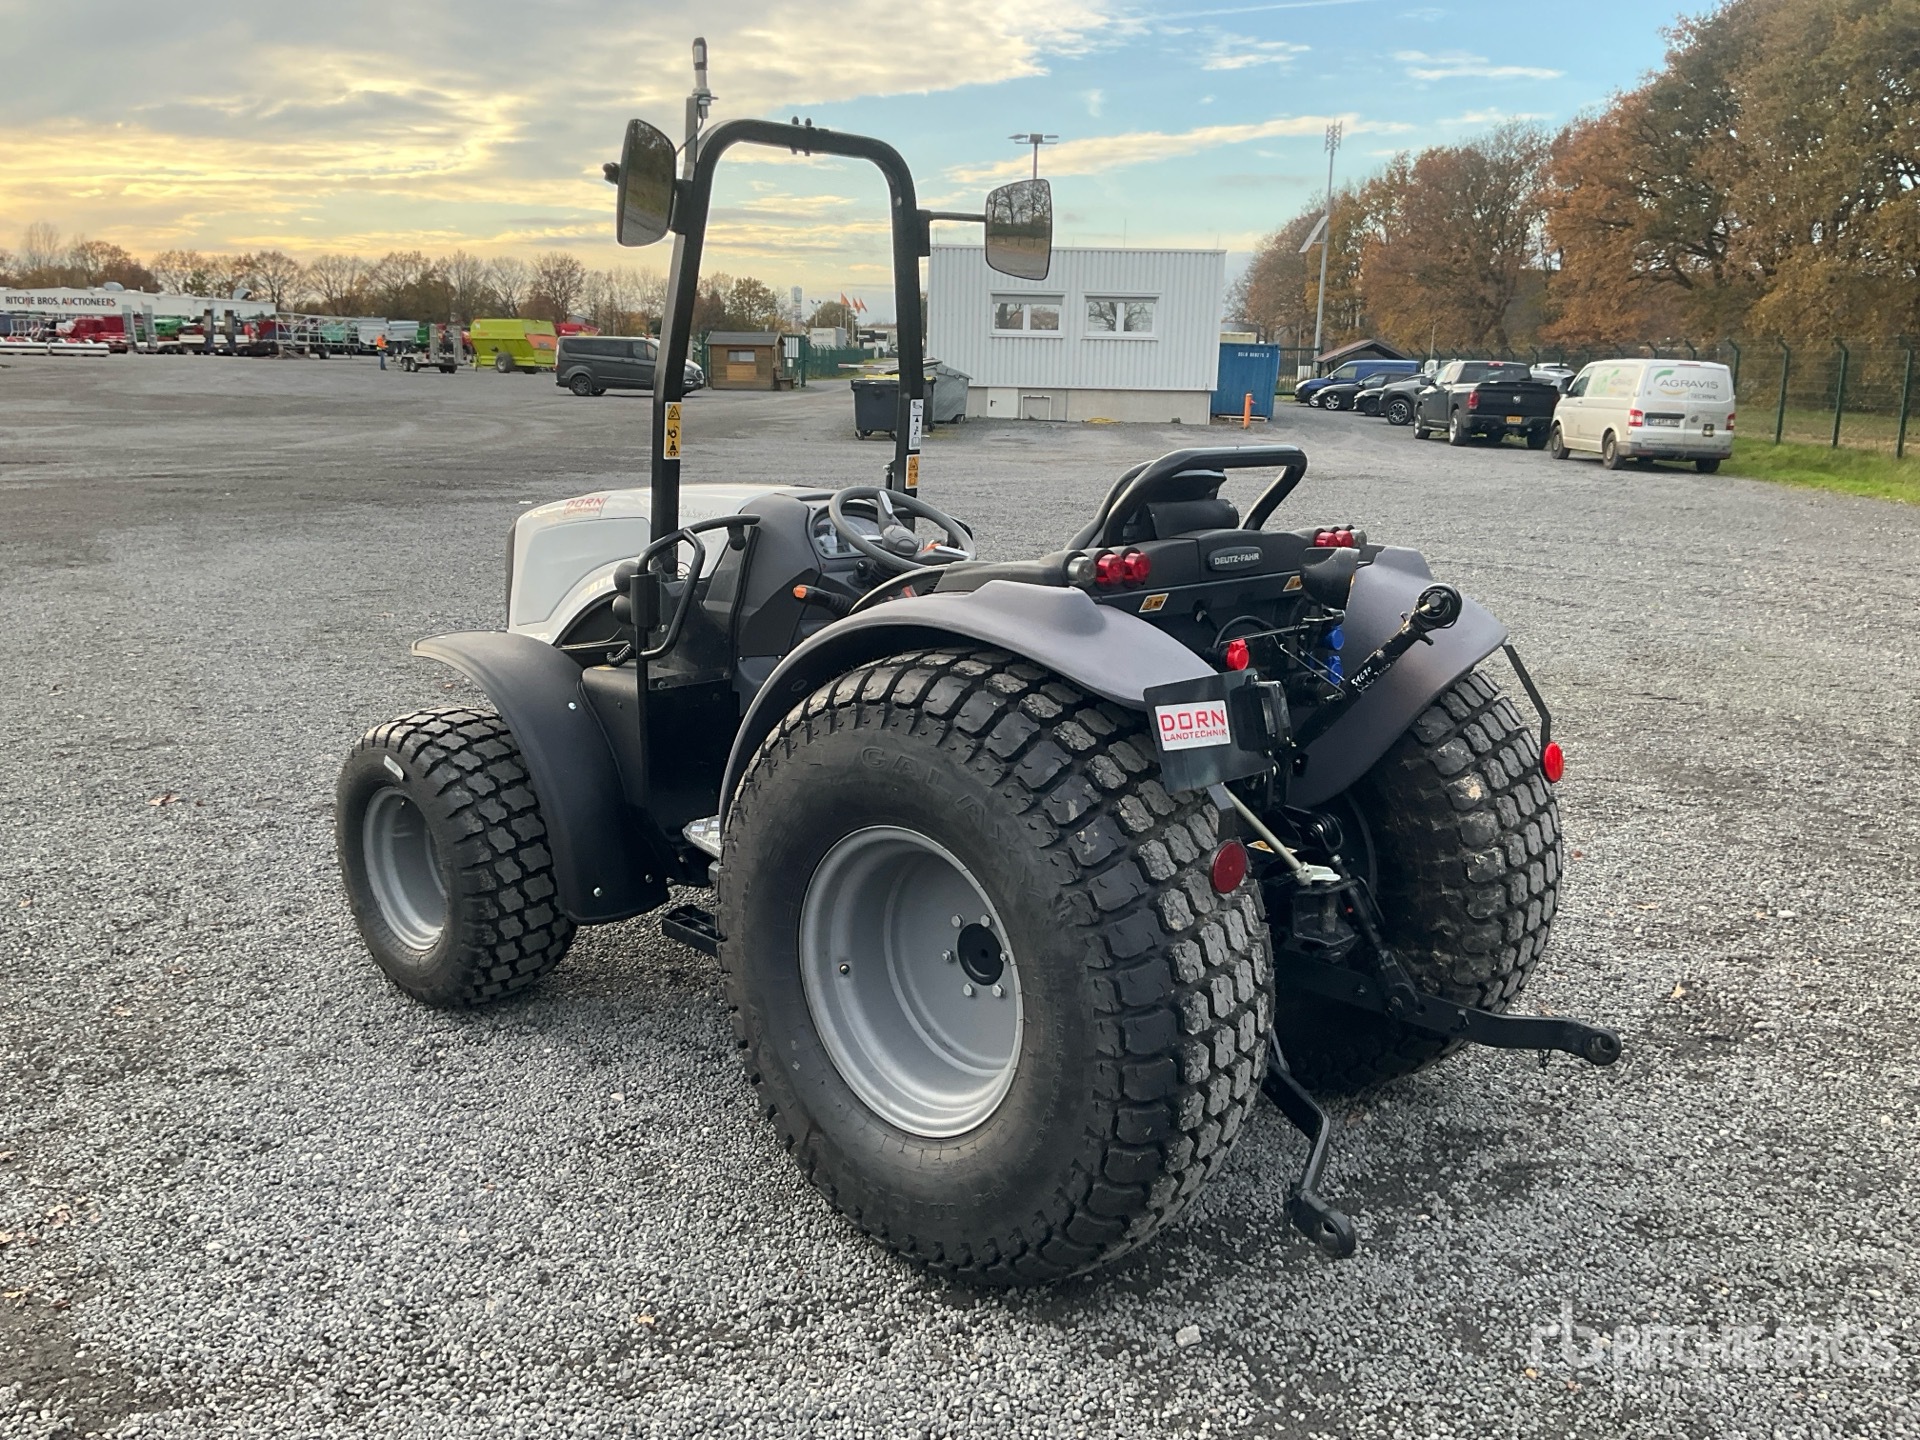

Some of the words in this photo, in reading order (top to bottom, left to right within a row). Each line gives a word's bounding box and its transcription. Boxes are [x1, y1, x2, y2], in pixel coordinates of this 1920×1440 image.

[5, 296, 35, 305] RITCHIE
[62, 297, 116, 307] AUCTIONEERS
[1659, 379, 1719, 389] AGRAVIS
[1214, 552, 1259, 565] DEUTZ-FAHR
[1160, 709, 1226, 732] DORN
[1163, 728, 1227, 742] LANDTECHNIK
